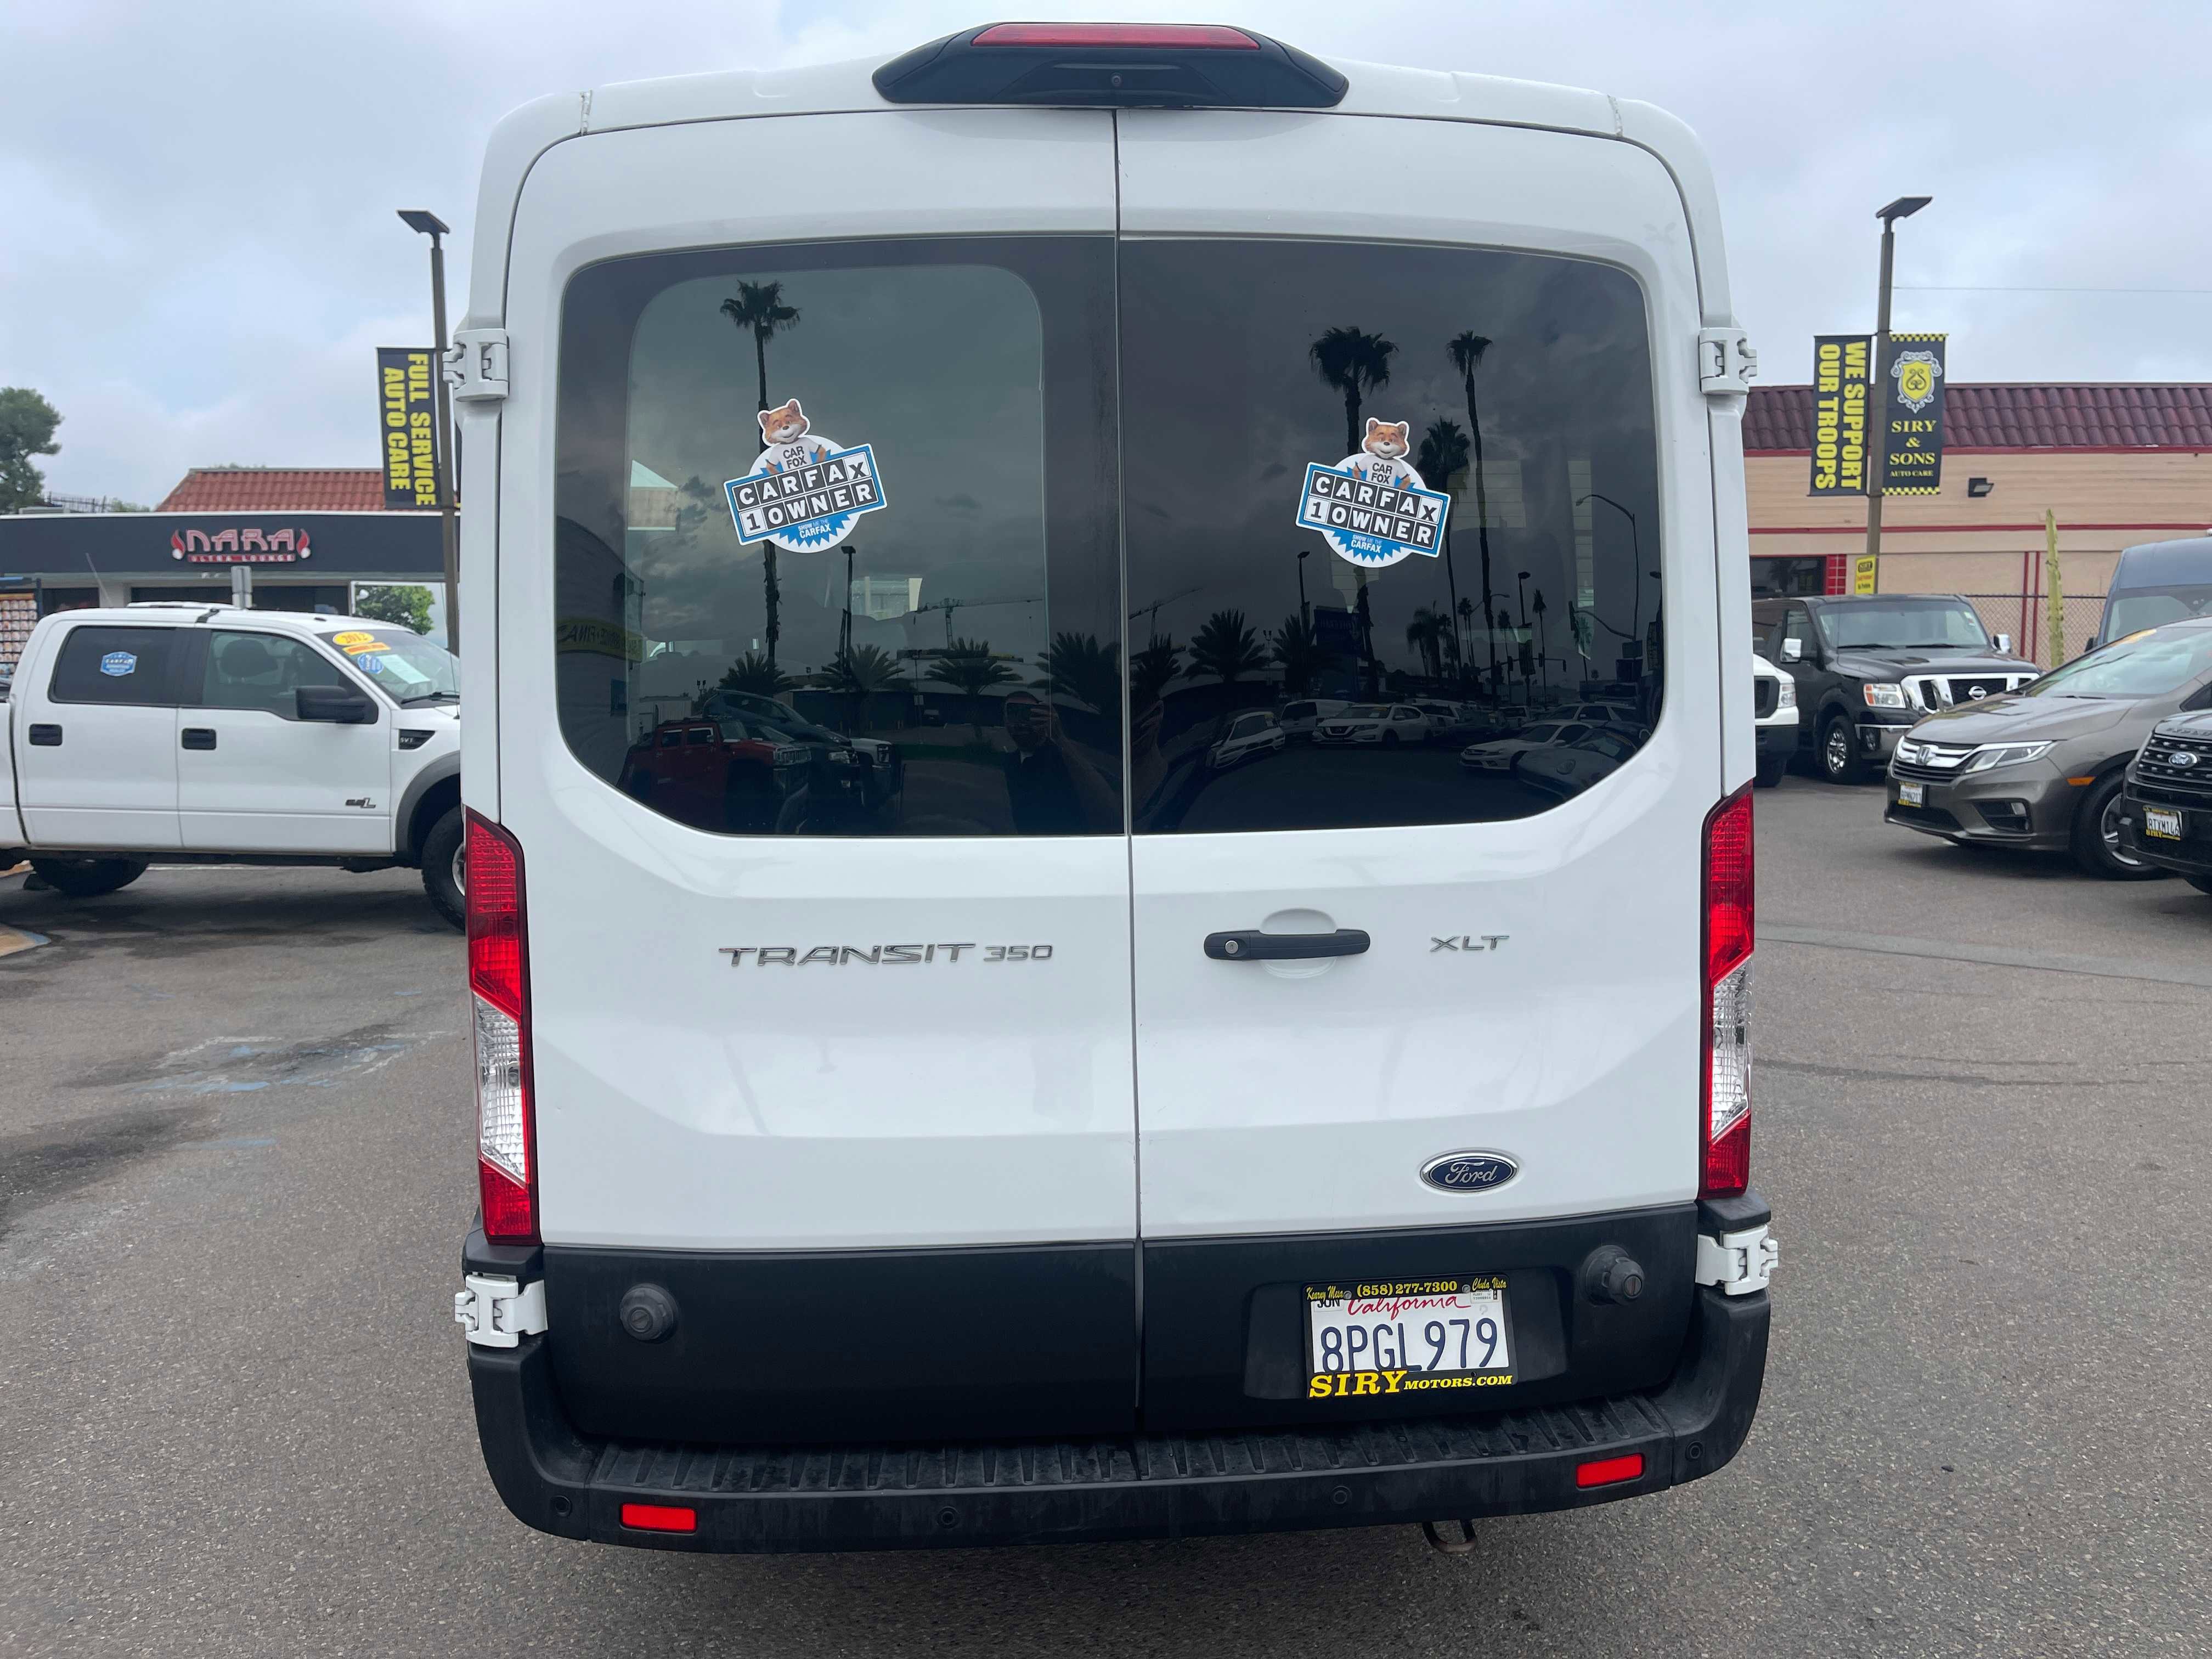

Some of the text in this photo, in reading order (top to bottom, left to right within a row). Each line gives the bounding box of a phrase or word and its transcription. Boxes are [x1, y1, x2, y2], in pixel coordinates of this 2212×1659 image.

[1815, 343, 1841, 489] OUR TROOPS
[1841, 341, 1866, 490] WE SUPPORT
[1891, 420, 1937, 433] SIRY
[384, 367, 411, 490] AUTO CARE
[407, 353, 436, 506] FULL SERVICE
[783, 446, 804, 459] CAR
[1905, 437, 1921, 448] &
[787, 456, 807, 469] FOX
[1372, 462, 1392, 475] CAR
[1889, 452, 1936, 465] SONS
[739, 461, 866, 505] CARFAX
[1371, 472, 1390, 484] FOX
[1316, 476, 1437, 522] CARFAX
[186, 529, 295, 552] NARA
[799, 523, 832, 538] CARFAX
[1351, 539, 1382, 554] CARFAX
[718, 942, 1053, 967] TRANSIT 350
[1430, 935, 1510, 952] XLT
[1444, 1161, 1498, 1184] Ford
[1357, 1283, 1393, 1297] (858)
[1395, 1280, 1458, 1294] 277-7300
[1347, 1294, 1471, 1321] California
[1320, 1317, 1498, 1372] 8PGL979
[1308, 1370, 1513, 1397] SIRY MOTORS.COM
